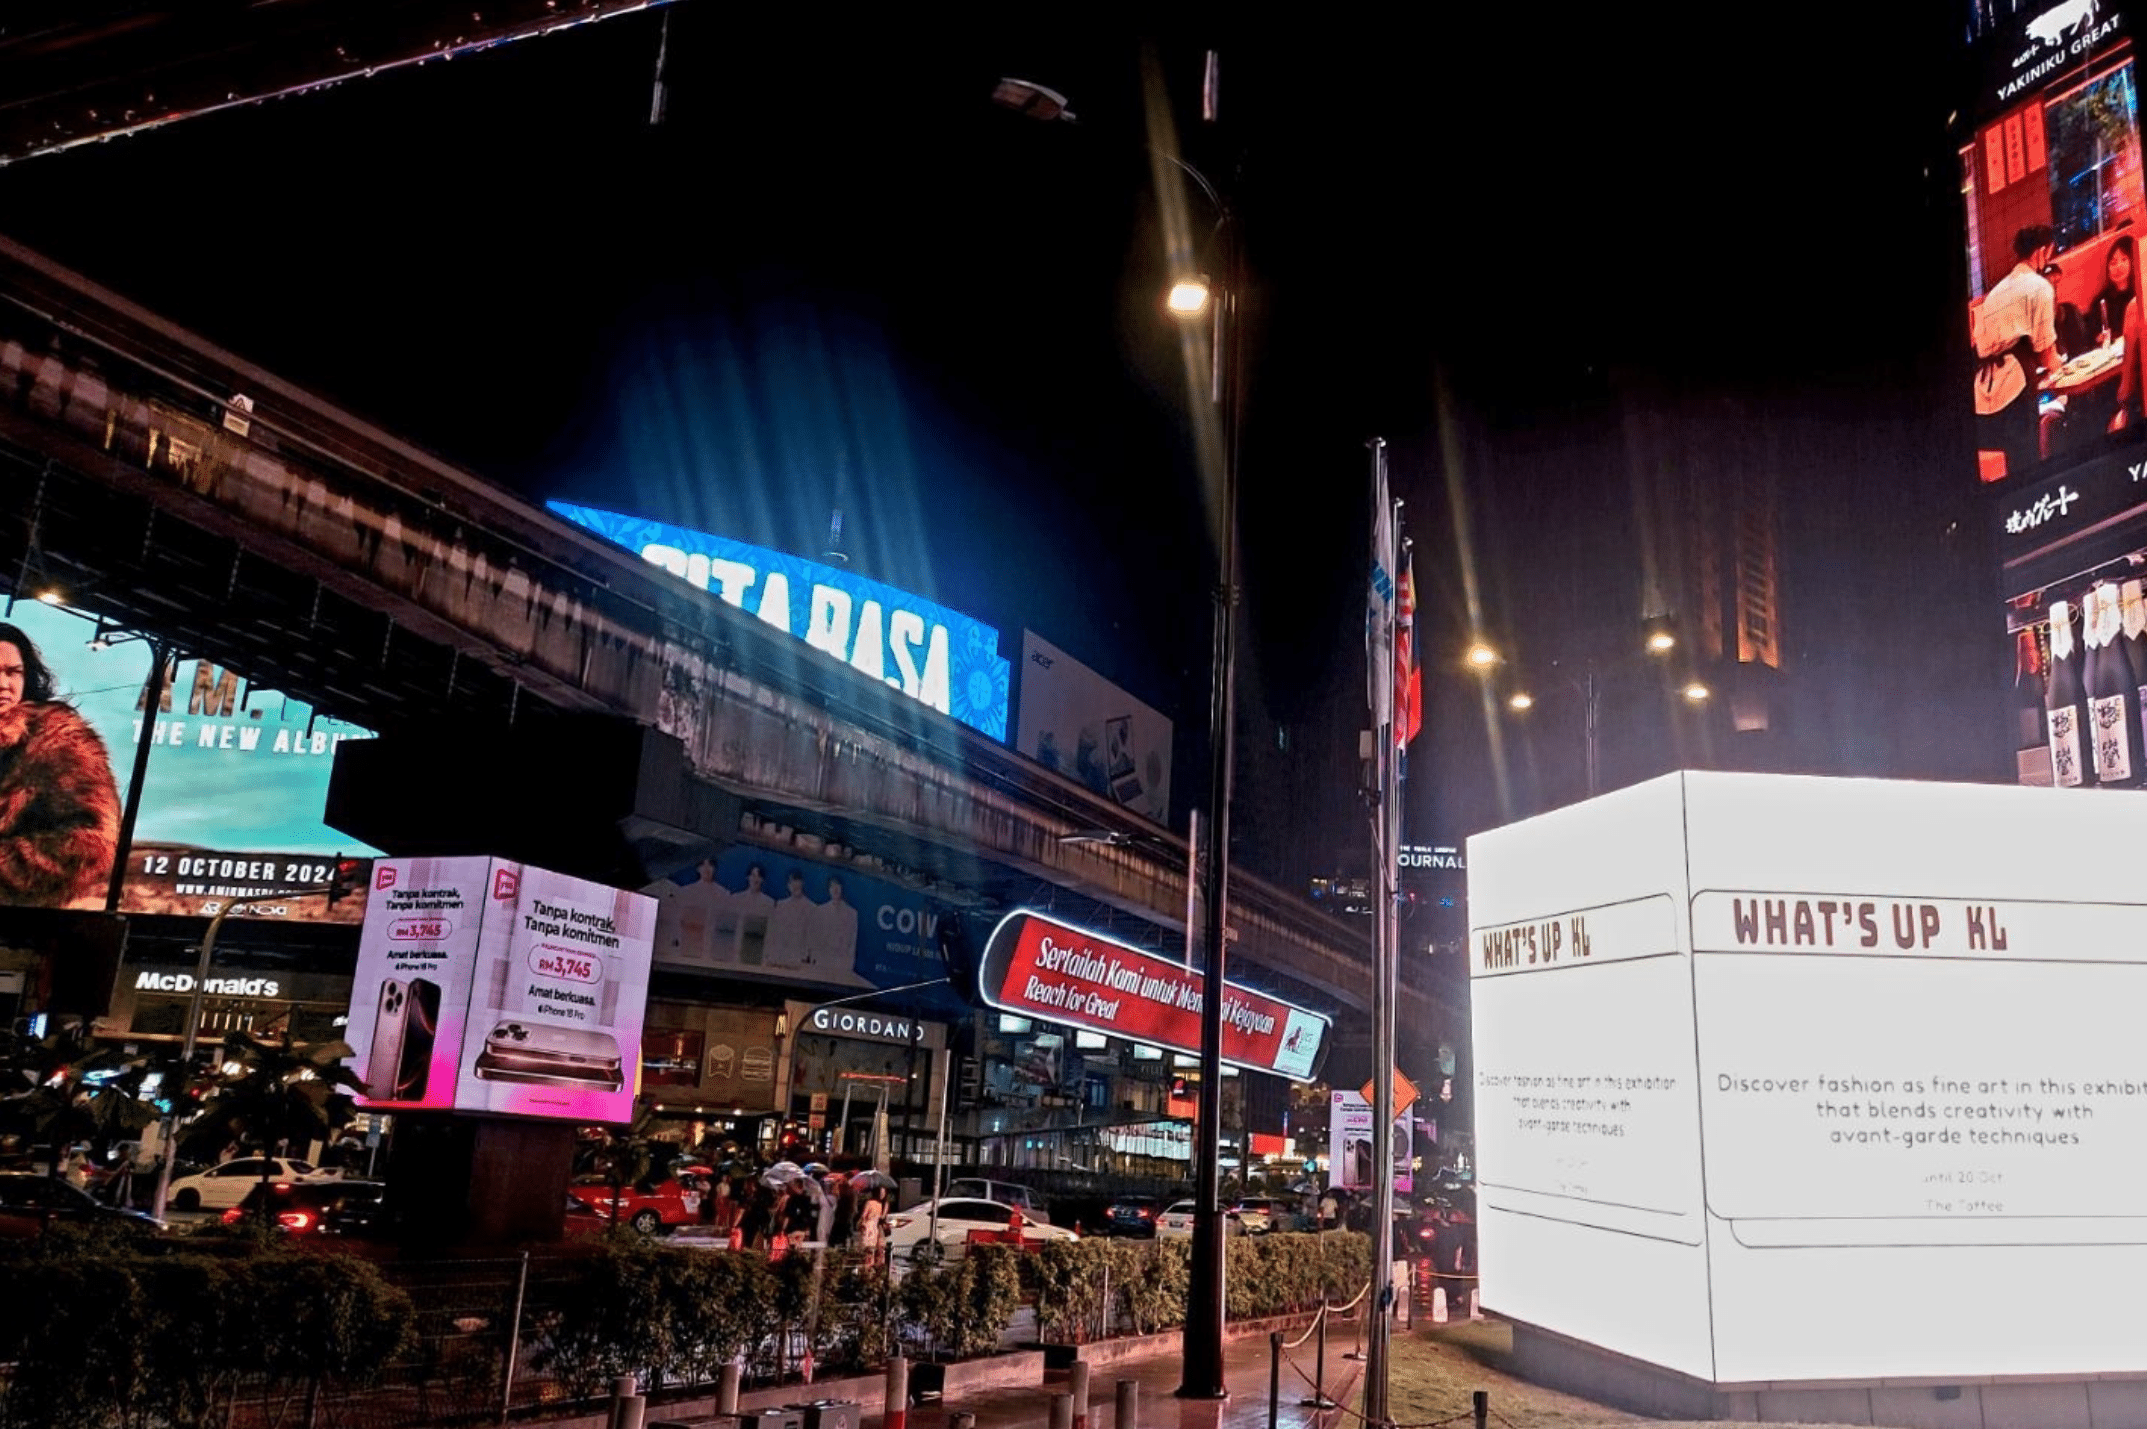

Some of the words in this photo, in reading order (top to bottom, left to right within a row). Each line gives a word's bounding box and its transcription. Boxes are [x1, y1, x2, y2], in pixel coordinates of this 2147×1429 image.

[1997, 50, 2065, 100] YAKINIKU
[2070, 13, 2120, 54] GREAT
[2128, 460, 2147, 482] Y
[133, 720, 186, 746] THE
[198, 724, 261, 751] NEW
[143, 856, 169, 875] 12
[178, 857, 276, 881] OCTOBER
[1397, 853, 1466, 869] OURNAL
[533, 900, 568, 921] Tanpa
[570, 908, 616, 933] kontrak,
[1733, 898, 1878, 948] WHAT'S
[1892, 903, 1941, 950] UP
[1966, 906, 2008, 951] KL
[524, 916, 560, 937] Tanpa
[562, 923, 620, 949] komitmen
[1483, 925, 1536, 969] WHAT'S
[1541, 920, 1562, 963] UP
[1571, 915, 1591, 957] KL
[528, 984, 553, 999] Amat
[1025, 975, 1065, 1006] Reach
[1066, 979, 1086, 1012] for
[1084, 994, 1121, 1021] Great
[1105, 959, 1144, 995] Kami
[1140, 976, 1178, 1007] untuk
[1229, 999, 1275, 1035] Kejayaan
[1717, 1073, 1809, 1093] Discover
[1818, 1074, 1895, 1094] fashion
[1902, 1079, 1925, 1094] as
[1932, 1076, 1971, 1095] fine
[1978, 1078, 2008, 1095] art
[2015, 1077, 2032, 1095] in
[2039, 1076, 2076, 1096] this
[1817, 1101, 1861, 1118] that
[1868, 1101, 1936, 1120] blends
[1943, 1102, 2043, 1123] creativity
[2052, 1102, 2093, 1120] with
[1830, 1126, 1961, 1149] avant-garde
[1969, 1127, 2080, 1150] techniques
[1958, 1171, 1973, 1183] 20
[1924, 1199, 1952, 1212] The
